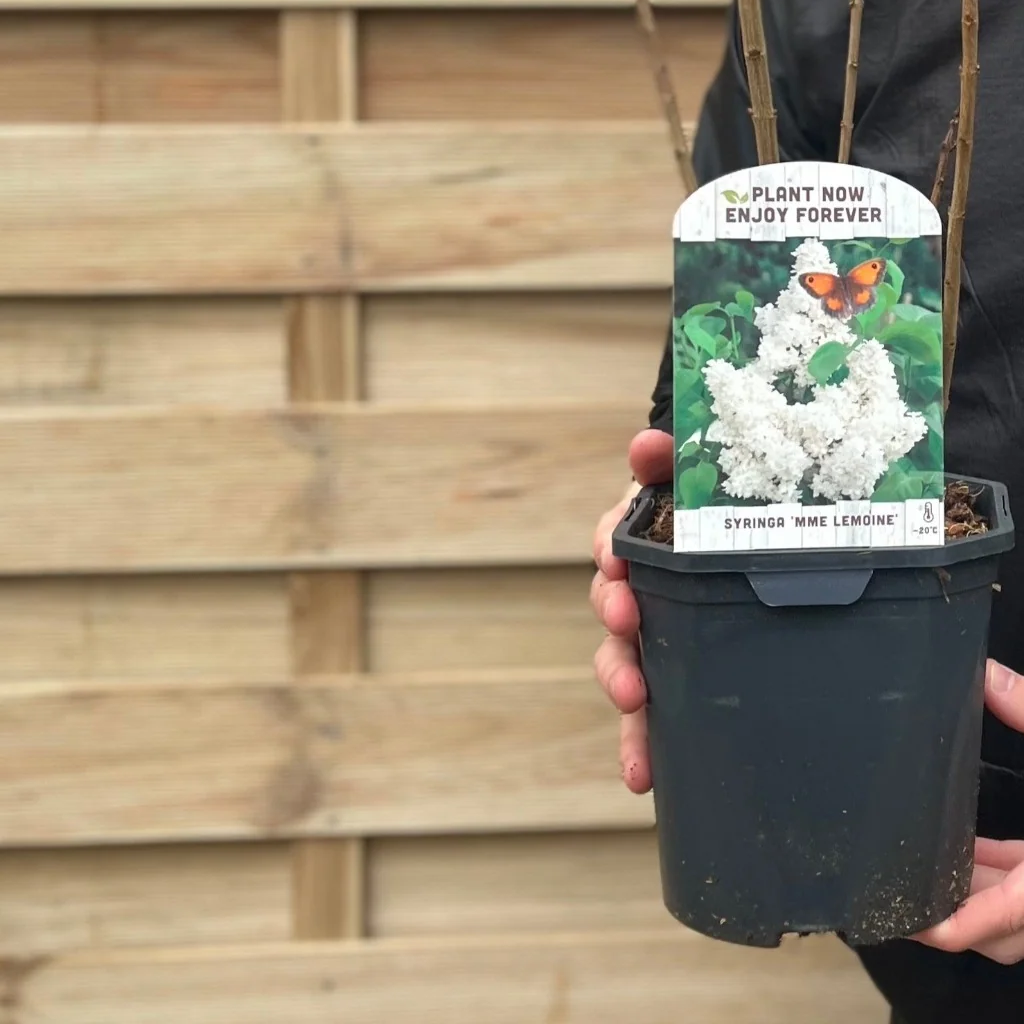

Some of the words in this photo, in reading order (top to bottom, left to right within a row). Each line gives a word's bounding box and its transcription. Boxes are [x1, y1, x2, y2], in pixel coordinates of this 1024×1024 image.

[752, 186, 814, 202] PLANT
[822, 186, 865, 202] NOW
[725, 207, 788, 223] ENJOY
[796, 207, 882, 223] FOREVER
[724, 517, 785, 530] SYRINGA
[791, 515, 828, 528] 'MME
[833, 513, 898, 527] LEMOINE'
